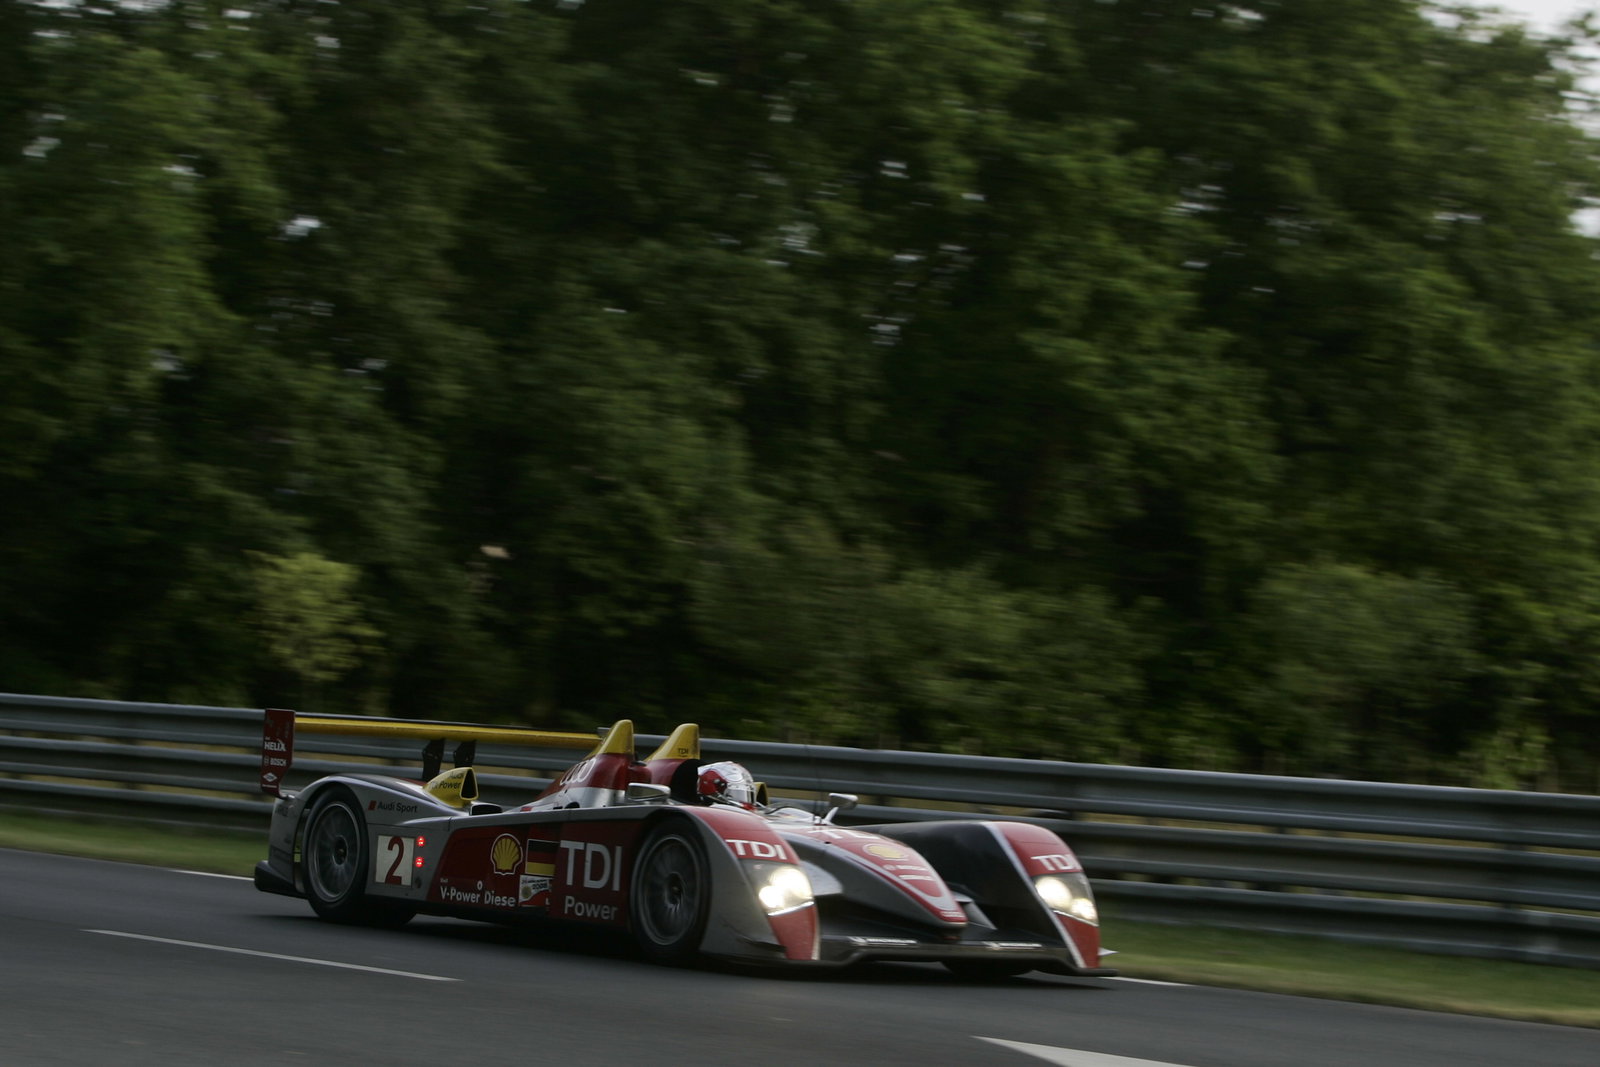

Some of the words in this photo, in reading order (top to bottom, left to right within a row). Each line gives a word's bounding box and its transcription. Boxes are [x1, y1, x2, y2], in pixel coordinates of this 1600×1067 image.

[264, 739, 287, 751] HELIX
[439, 781, 462, 790] Power
[377, 801, 396, 810] Audi
[396, 803, 418, 813] Sport
[725, 839, 787, 860] TDI
[385, 836, 404, 885] 2
[560, 839, 622, 891] TDI
[563, 895, 619, 920] Power
